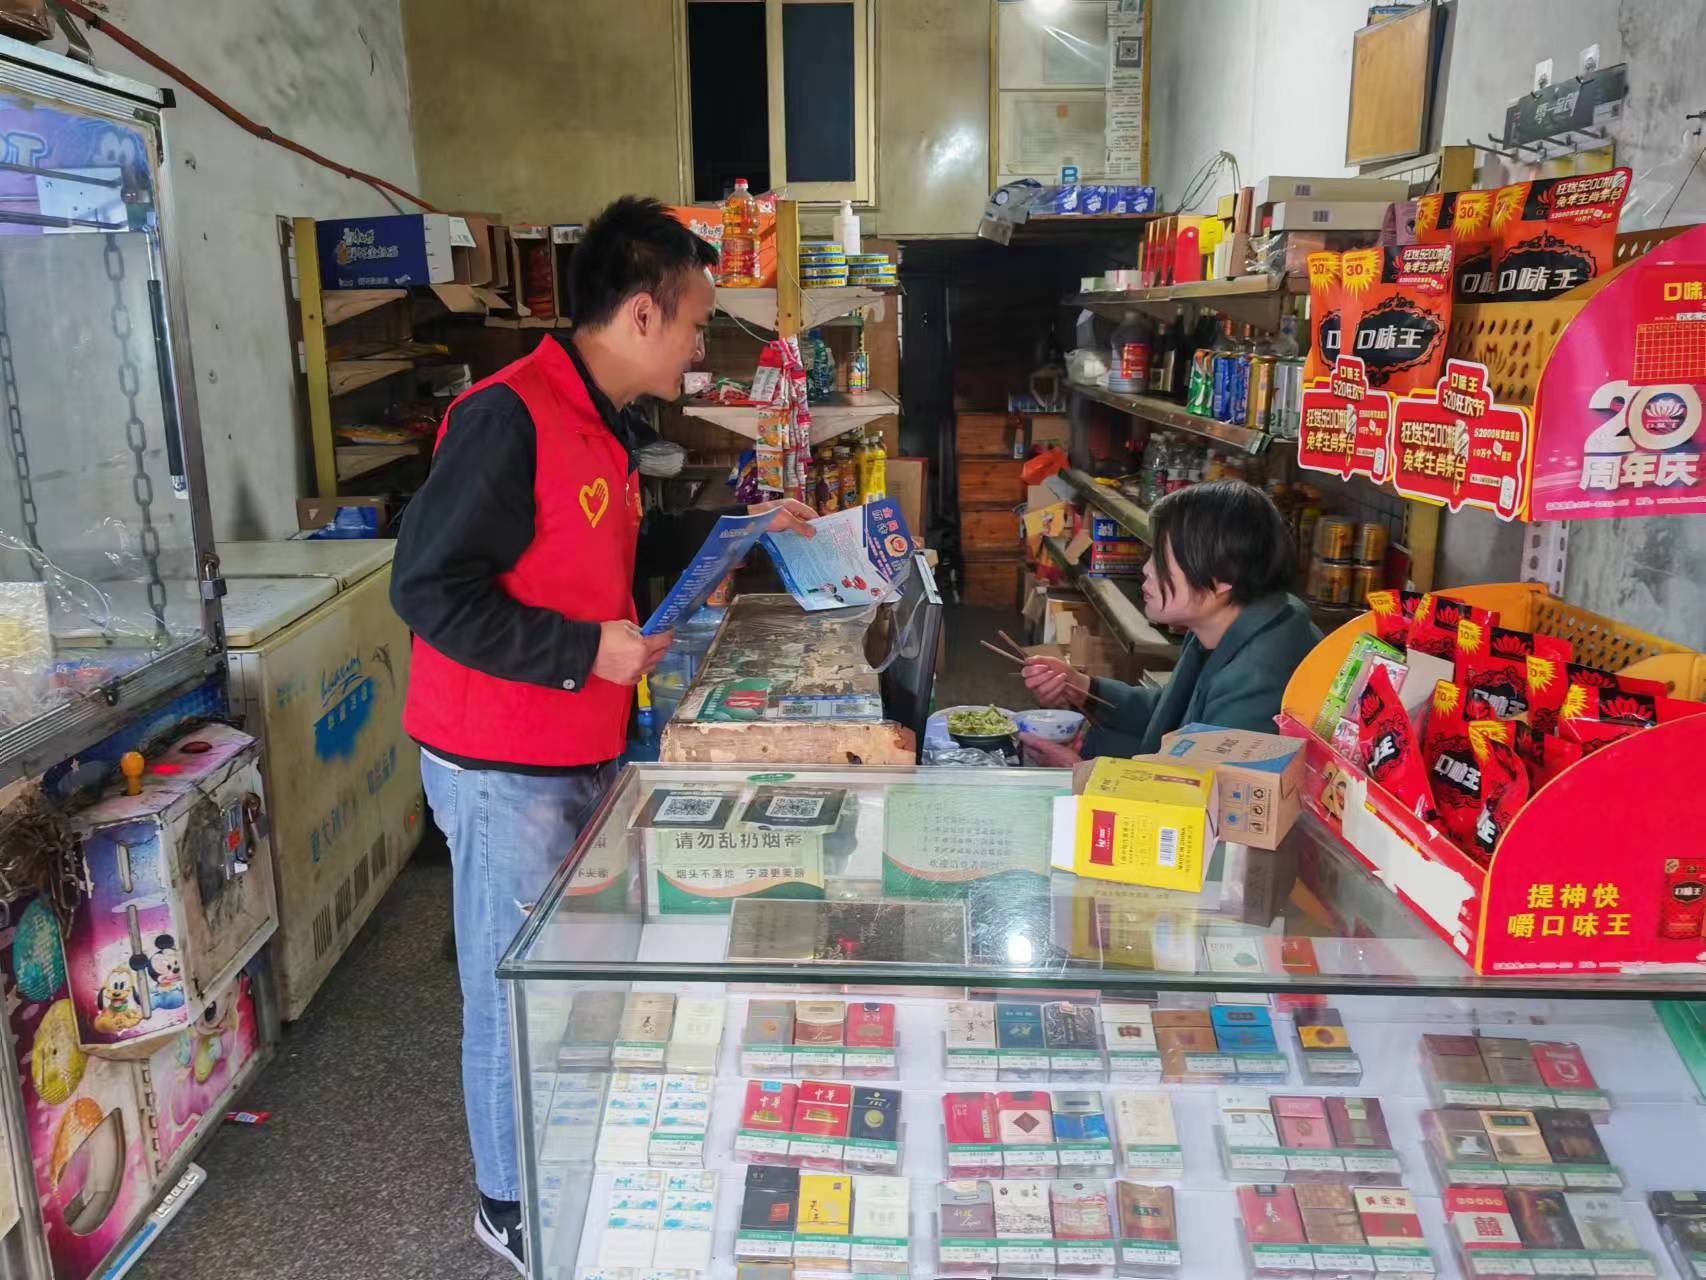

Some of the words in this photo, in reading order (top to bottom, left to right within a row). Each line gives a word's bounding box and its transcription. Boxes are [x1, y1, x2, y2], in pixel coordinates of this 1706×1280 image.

[1500, 267, 1578, 292] 口味王
[1664, 281, 1706, 301] 口味
[1357, 325, 1425, 350] 口味王
[1451, 373, 1479, 393] 口味王
[1443, 389, 1486, 417] 520狂欢节
[1584, 380, 1703, 453] 20
[1403, 448, 1467, 482] 兔年生肖茅台
[1579, 452, 1701, 491] 周年庆
[1434, 753, 1482, 791] 口味王
[1527, 883, 1621, 909] 提神快
[1507, 912, 1633, 938] 嚼口味王
